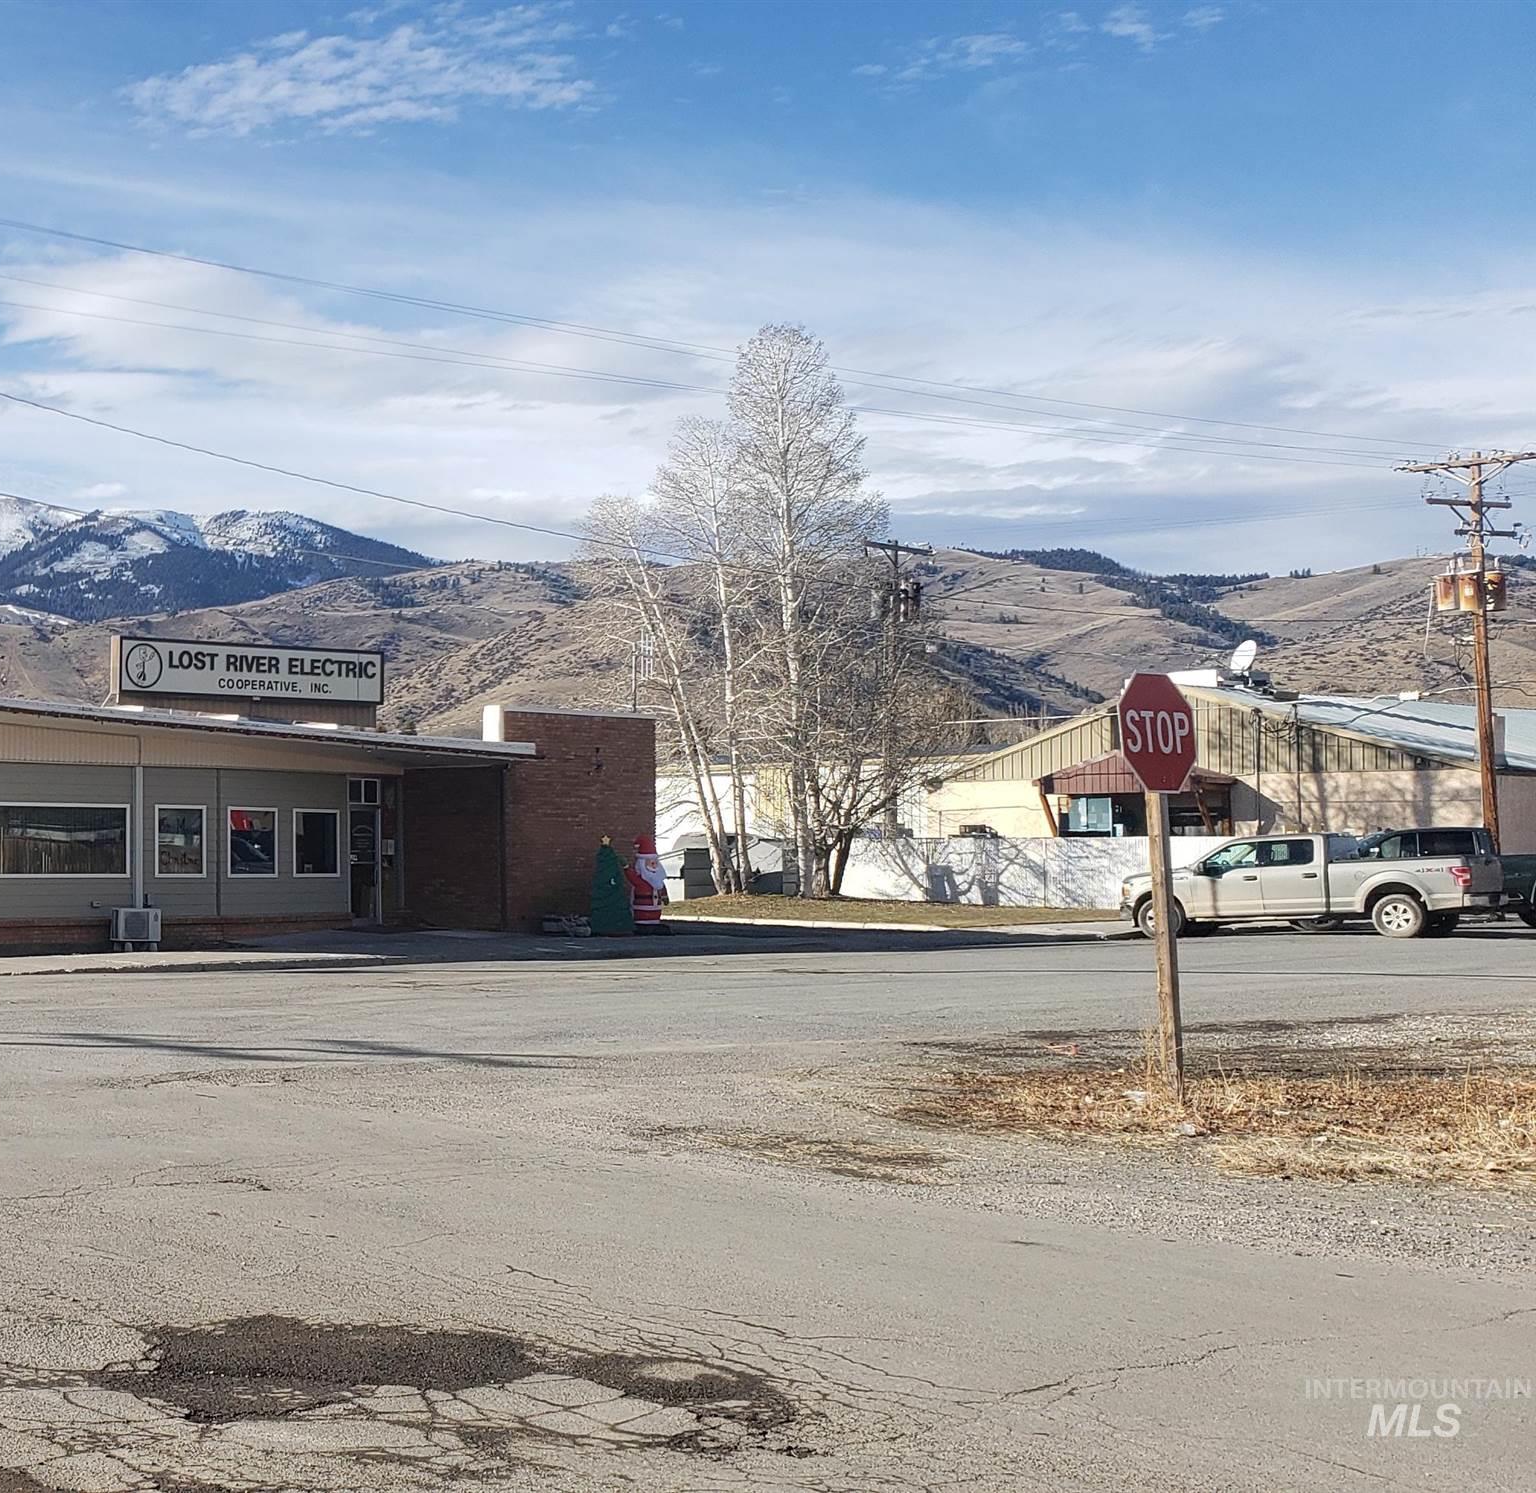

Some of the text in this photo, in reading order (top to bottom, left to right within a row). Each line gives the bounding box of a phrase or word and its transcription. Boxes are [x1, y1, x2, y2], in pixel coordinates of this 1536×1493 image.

[168, 650, 377, 680] LOST RIVER ELECTRIC
[218, 678, 332, 694] COOPERATIVE, INC.
[1125, 709, 1189, 754] STOP
